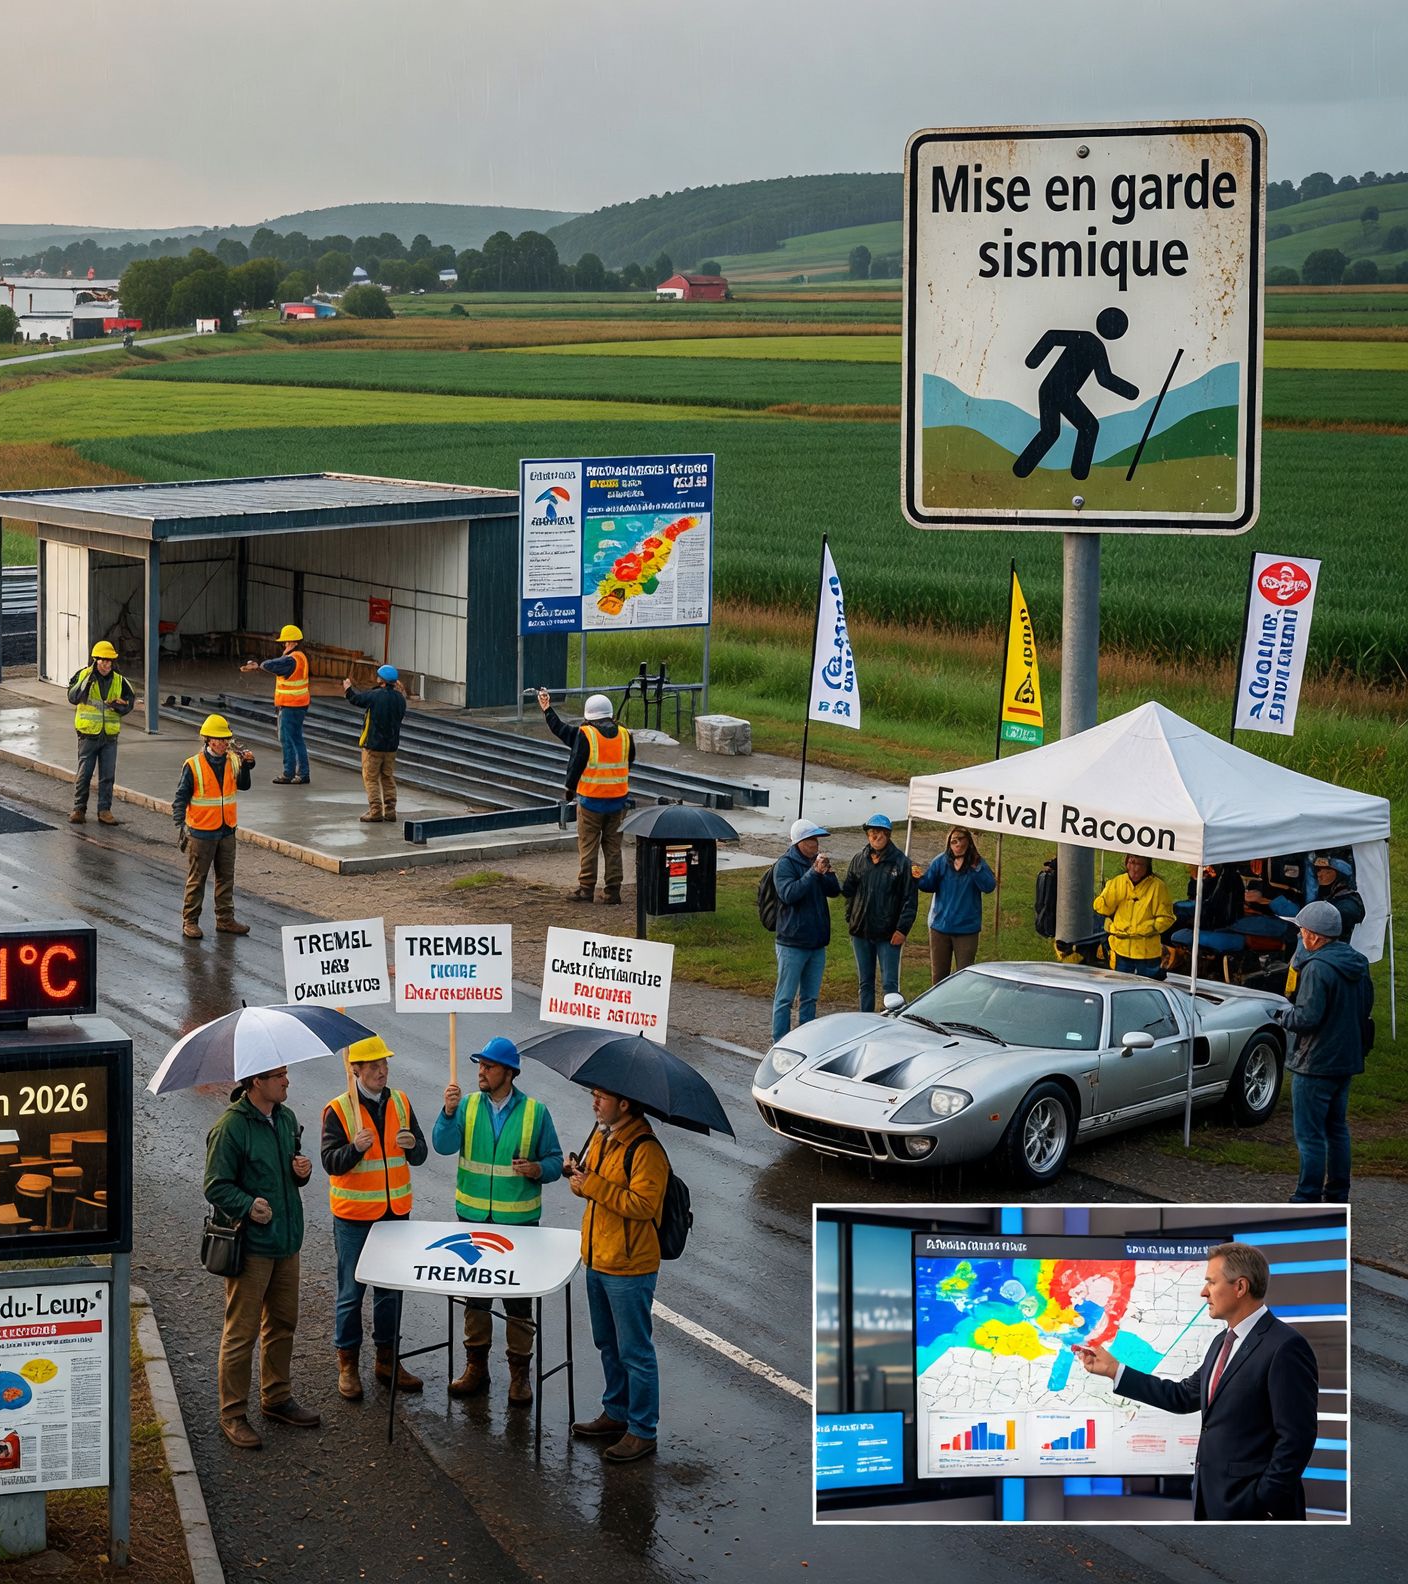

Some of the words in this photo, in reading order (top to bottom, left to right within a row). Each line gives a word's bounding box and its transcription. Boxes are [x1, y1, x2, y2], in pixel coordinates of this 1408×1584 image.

[931, 163, 1031, 213] Mise
[1045, 173, 1096, 212] en
[1110, 158, 1237, 225] garde
[978, 226, 1189, 292] sismique
[936, 786, 1048, 831] Festival
[1060, 804, 1176, 852] Racoon
[405, 936, 503, 956] TREMBSL
[18, 1082, 89, 1115] 2026
[413, 1265, 521, 1286] TREMBSL
